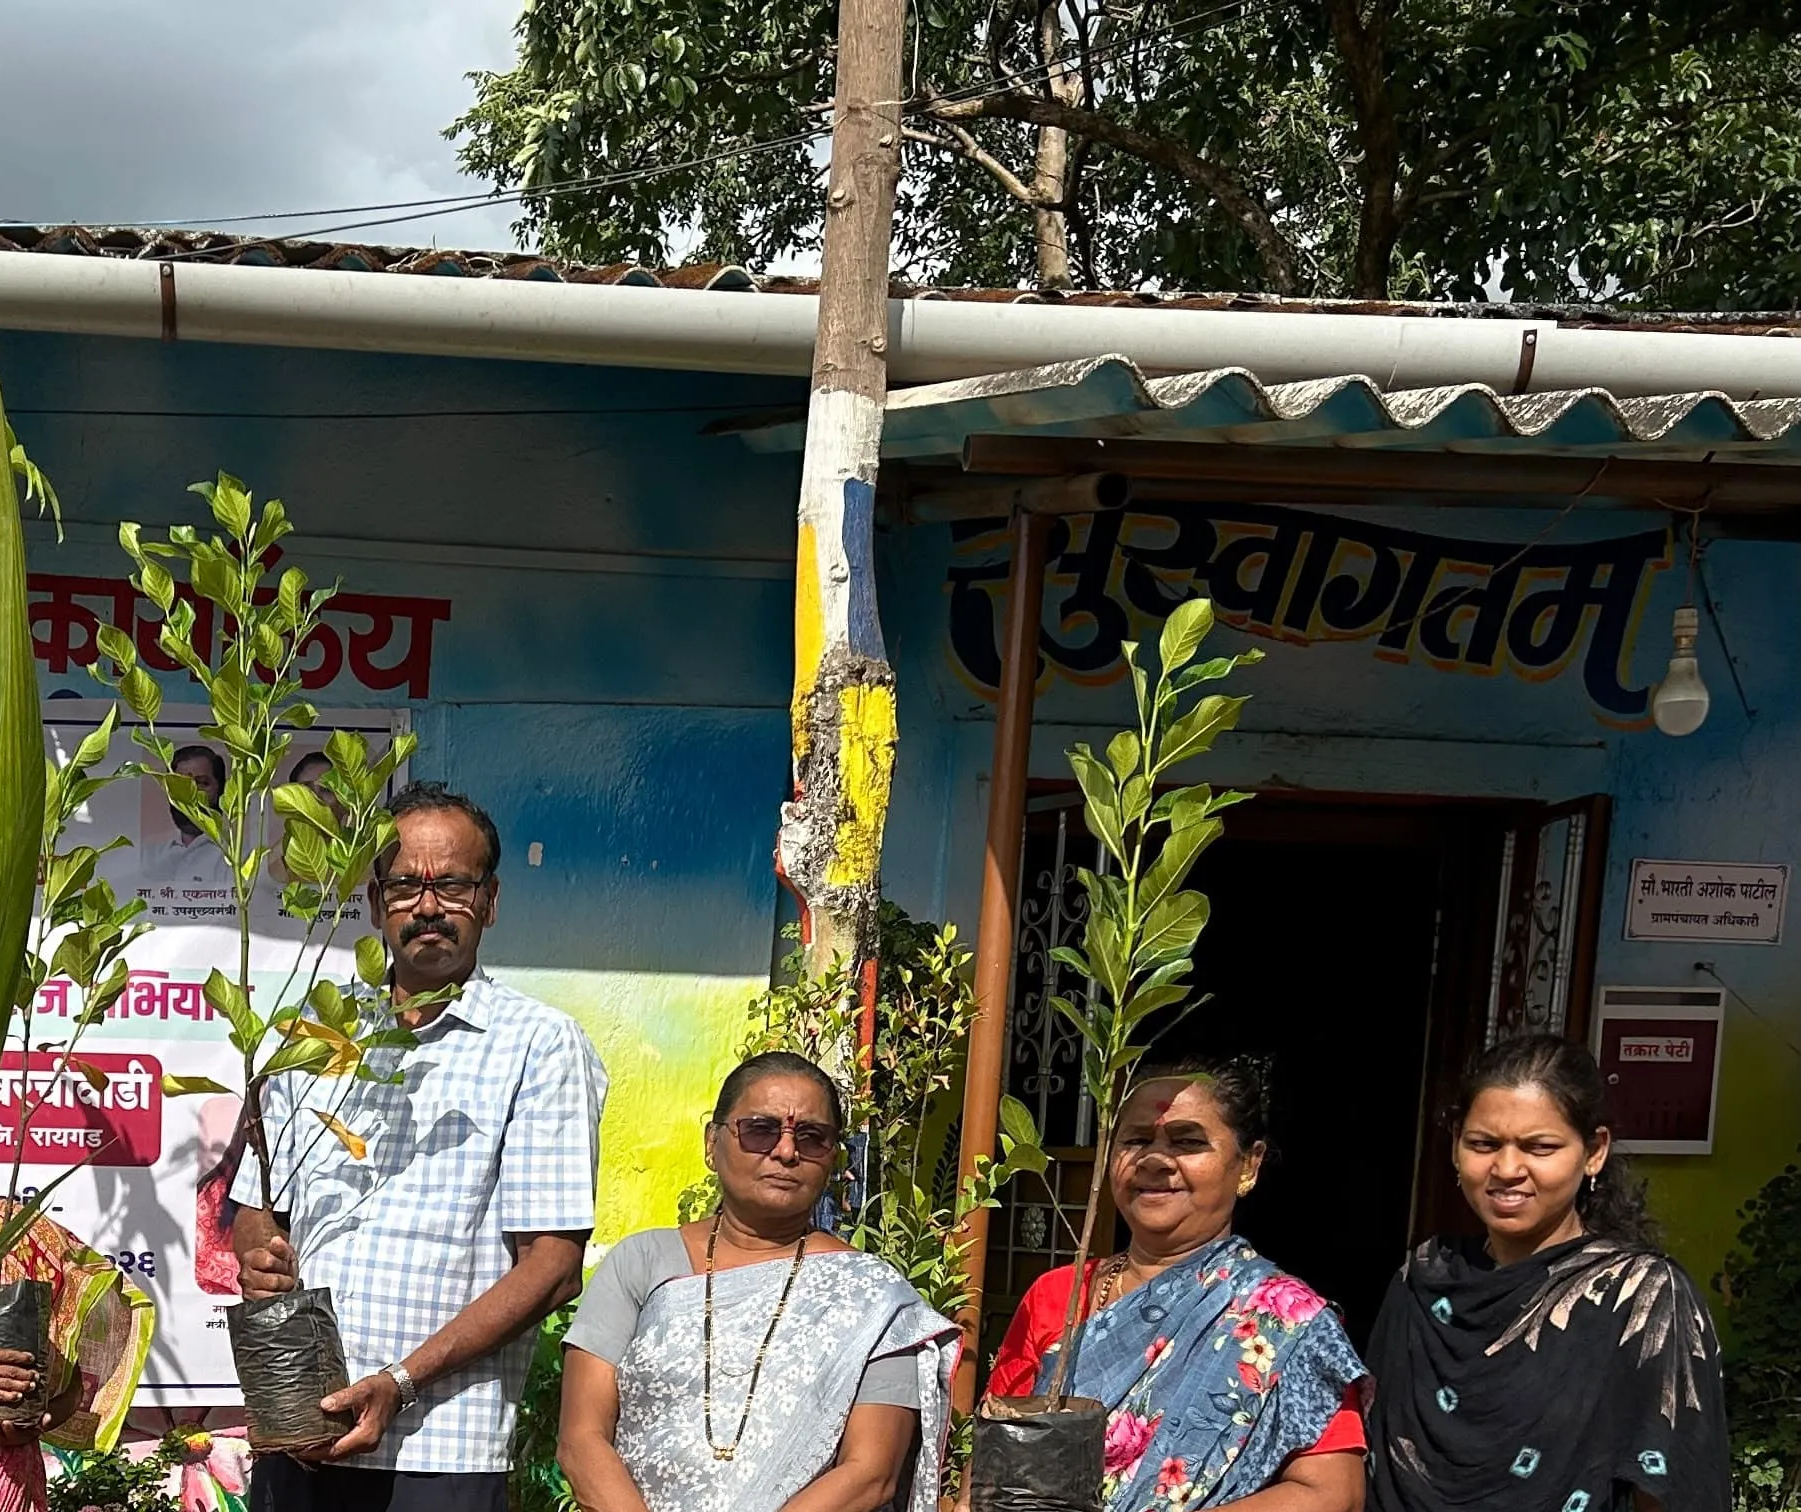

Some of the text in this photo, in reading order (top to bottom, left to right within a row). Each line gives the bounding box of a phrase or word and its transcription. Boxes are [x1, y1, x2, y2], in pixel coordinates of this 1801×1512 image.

[1697, 876, 1736, 899] अशोक
[1739, 878, 1778, 900] पाटील
[1712, 911, 1759, 927] अधिकारी
[1622, 1040, 1690, 1058] तक्रार पेटी
[29, 1127, 104, 1148] रायगड
